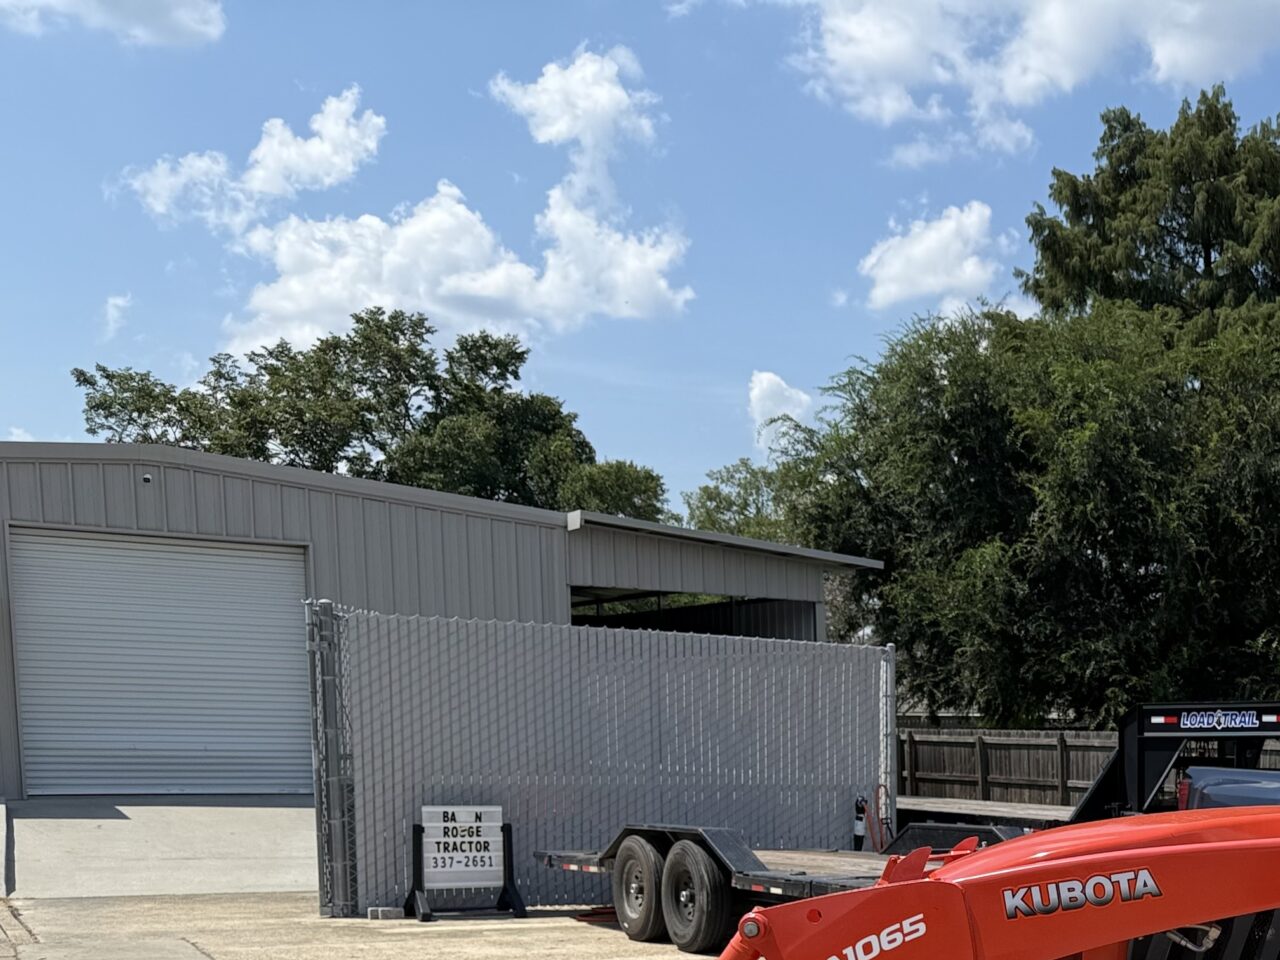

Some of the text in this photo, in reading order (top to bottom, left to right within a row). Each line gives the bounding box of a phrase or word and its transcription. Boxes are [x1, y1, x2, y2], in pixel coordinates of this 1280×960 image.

[1180, 710, 1260, 729] LOAD TRAIL
[435, 841, 490, 853] TRACTOR
[432, 855, 494, 869] 337-2651
[1003, 867, 1162, 919] KUBOTA
